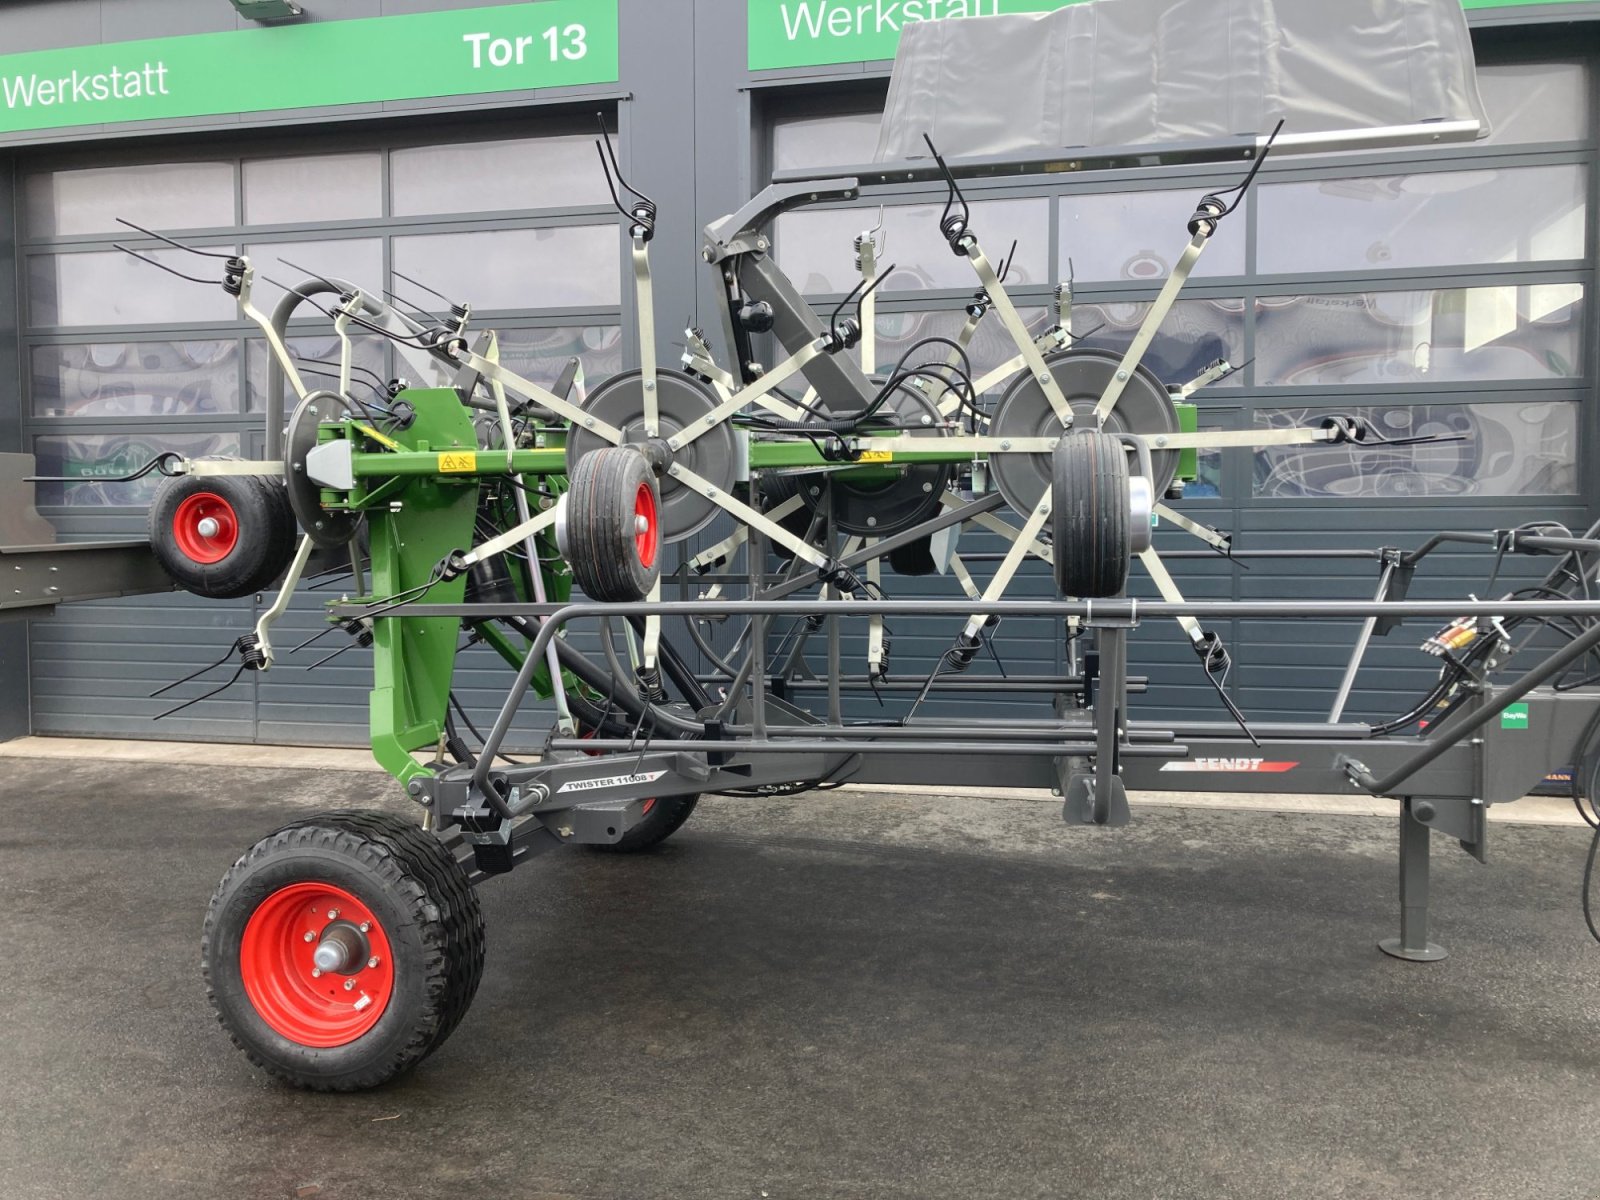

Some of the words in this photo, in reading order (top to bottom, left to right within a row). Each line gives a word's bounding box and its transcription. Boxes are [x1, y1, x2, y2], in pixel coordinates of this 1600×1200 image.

[463, 32, 533, 68] Tor
[542, 23, 588, 62] 13
[2, 61, 170, 109] Werkstatt
[1194, 758, 1264, 770] FENDT
[566, 779, 615, 790] TWISTER
